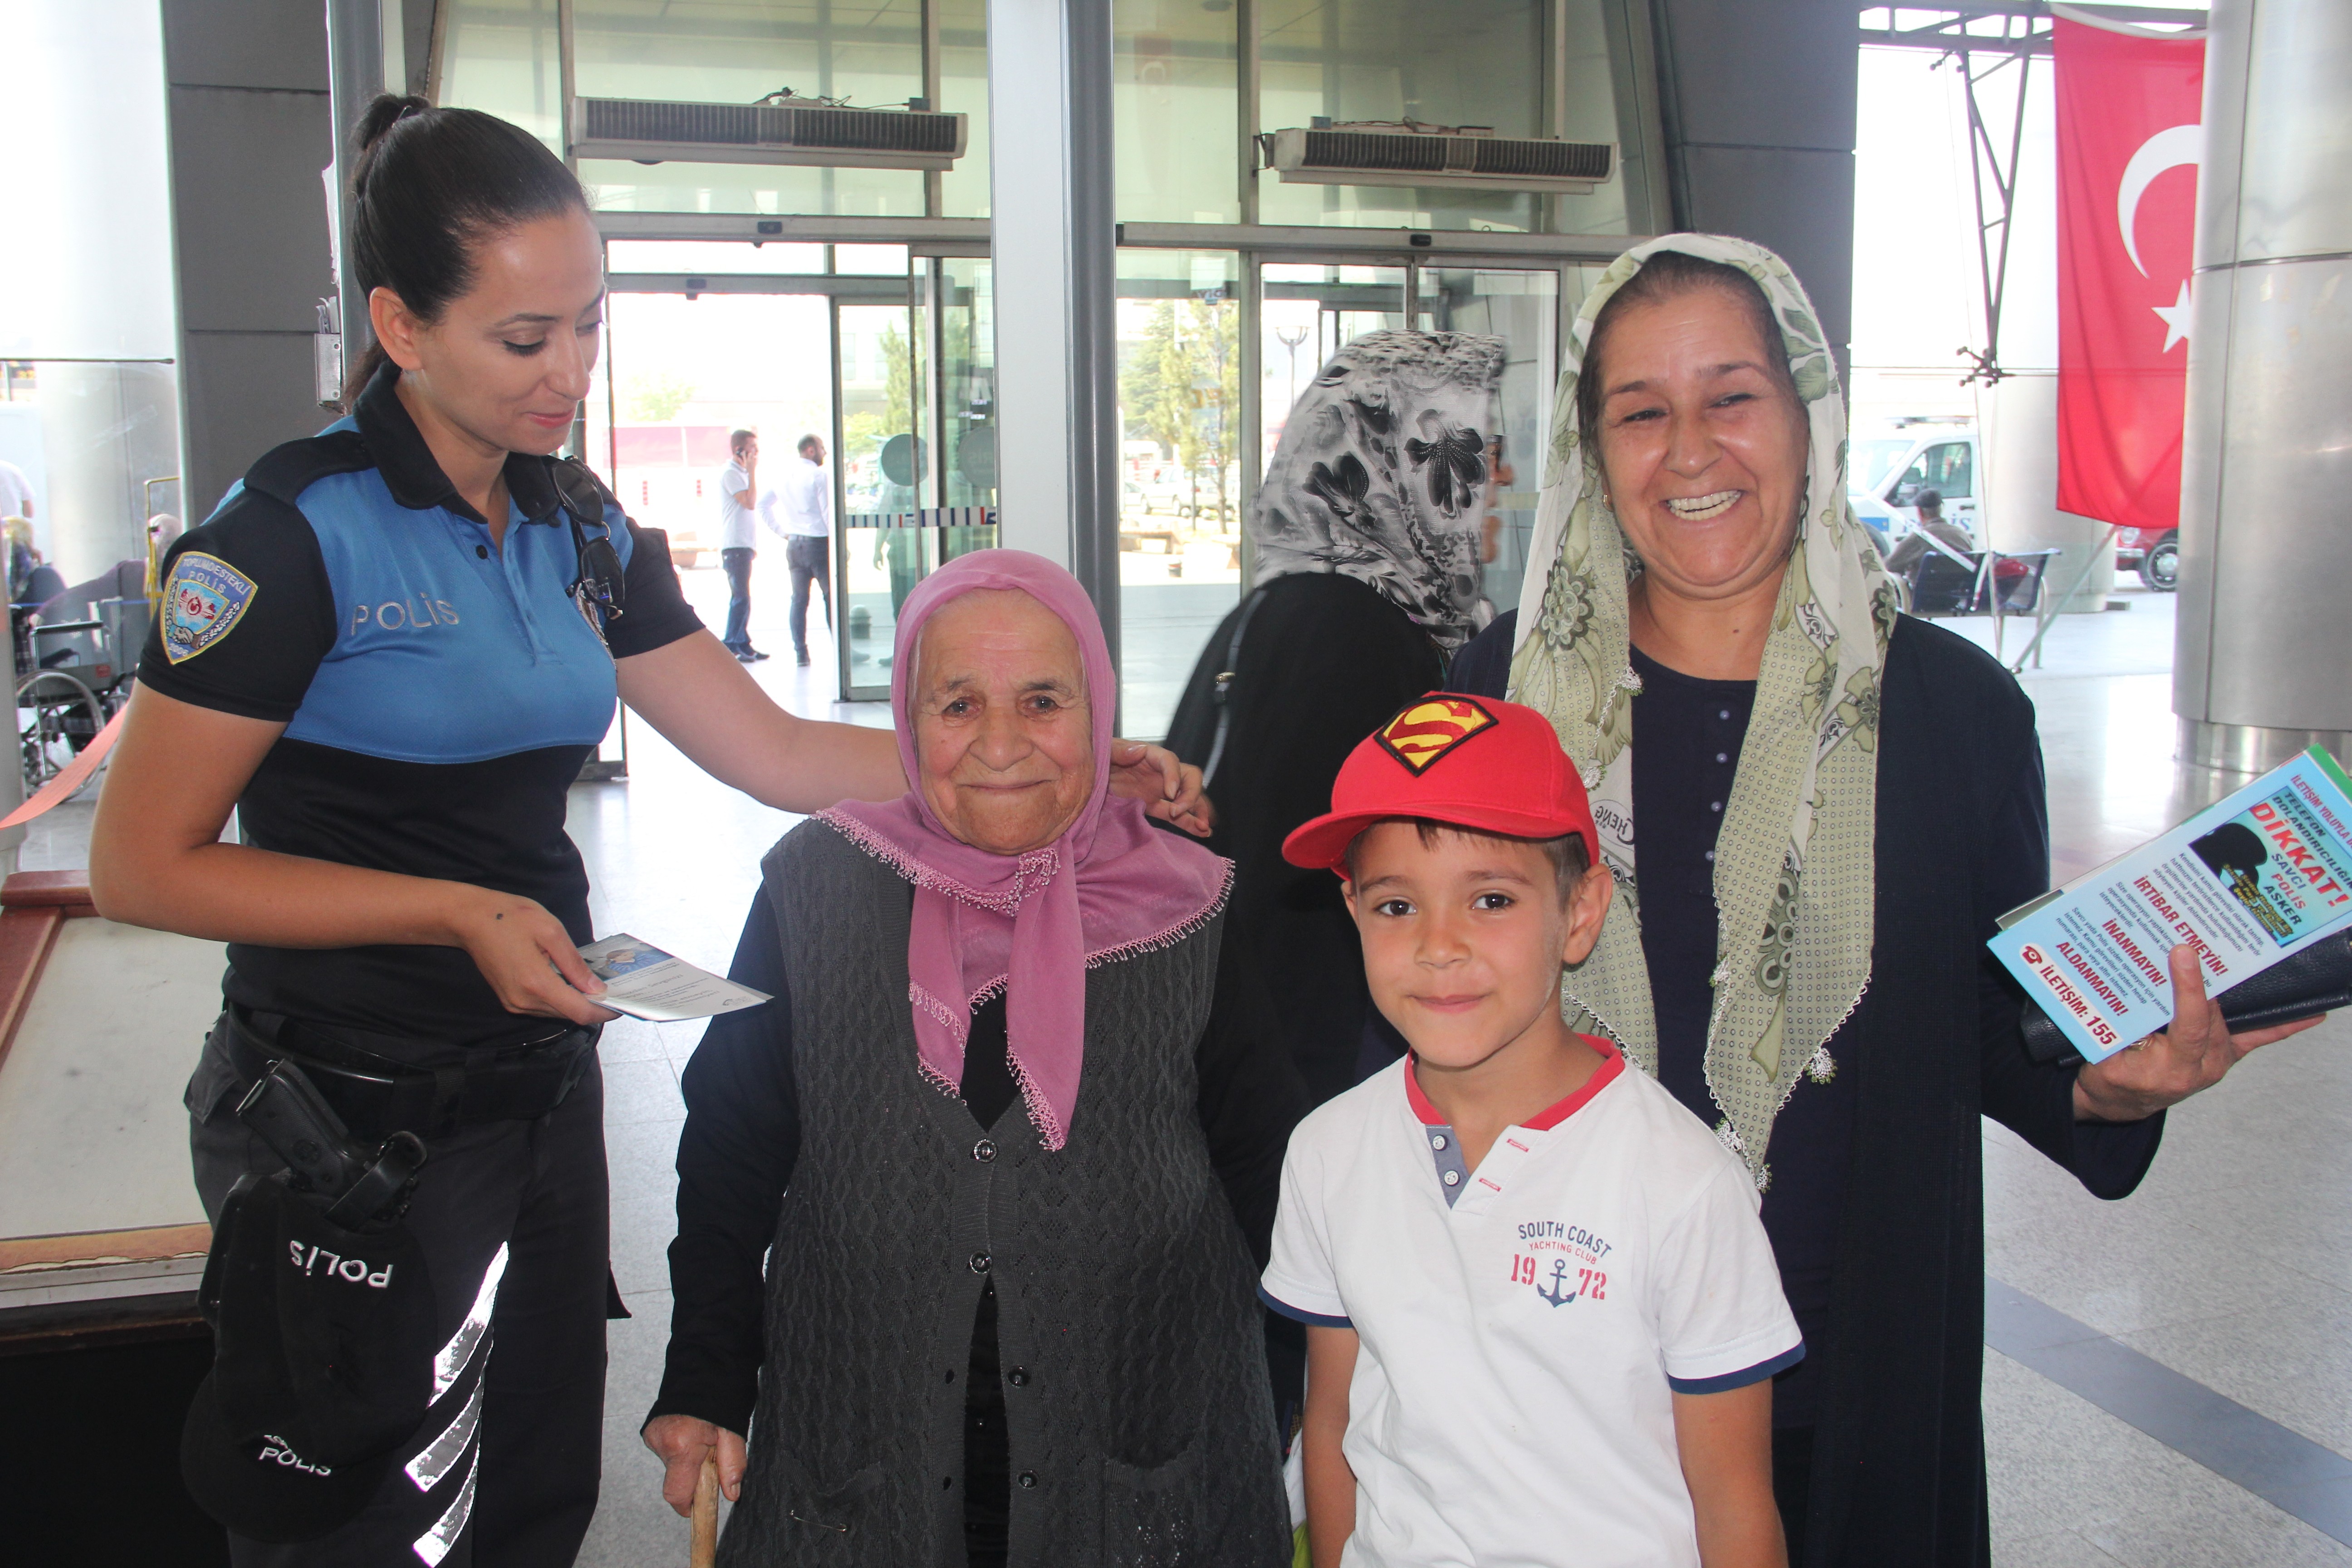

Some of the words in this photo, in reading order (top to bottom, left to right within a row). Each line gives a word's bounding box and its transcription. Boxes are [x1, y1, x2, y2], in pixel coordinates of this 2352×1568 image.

[351, 592, 460, 636] POLİS
[2285, 792, 2325, 836] TELEFON
[2290, 774, 2323, 808] İLETİŞİM
[2319, 806, 2350, 838] YOLUYLA
[2248, 802, 2349, 906] DİKKAT!
[2271, 853, 2306, 888] SAVCI
[2099, 892, 2133, 927] isteyeceklerdir.
[2116, 882, 2127, 893] Size
[2126, 893, 2150, 919] operasyon
[2152, 868, 2174, 890] söyleyen
[2172, 890, 2188, 906] kişiler
[2179, 853, 2202, 877] Kendisini
[2199, 876, 2214, 892] kamu
[2211, 891, 2234, 912] görevlisi
[2232, 912, 2248, 929] olarak
[2264, 886, 2301, 924] ASKER
[2271, 873, 2305, 909] POLİS
[2107, 887, 2137, 918] operasyonda
[2136, 917, 2160, 944] kullanmak
[2133, 876, 2179, 922] İRTİBAR
[2174, 921, 2228, 976] ETMEYİN!
[2072, 907, 2086, 922] Savcı
[2083, 921, 2097, 934] yada
[2096, 933, 2108, 946] Polis
[2107, 946, 2122, 963] sizden
[2121, 963, 2146, 988] operasyon
[2144, 987, 2154, 998] için
[2076, 941, 2089, 954] para
[2088, 953, 2100, 966] veya
[2098, 965, 2110, 977] altın
[2109, 977, 2128, 997] istemez.
[2082, 932, 2096, 948] Kamu
[2094, 947, 2120, 972] görevlileri
[2117, 972, 2133, 989] sizden
[2132, 988, 2146, 1004] hesap
[2102, 918, 2167, 986] İNANMAYIN!
[2247, 943, 2260, 956] terör
[2056, 942, 2128, 1016] ALDANMAYIN!
[2039, 965, 2087, 1017] İLETİŞİM:
[2087, 1016, 2117, 1044] 155
[1518, 1221, 1564, 1240] SOUTH
[1568, 1225, 1612, 1258] COAST
[1529, 1241, 1572, 1253] YACHTING
[1575, 1248, 1597, 1264] CLUB
[289, 1240, 394, 1288] POLİS
[1511, 1254, 1536, 1285] 19
[1579, 1268, 1607, 1300] 72
